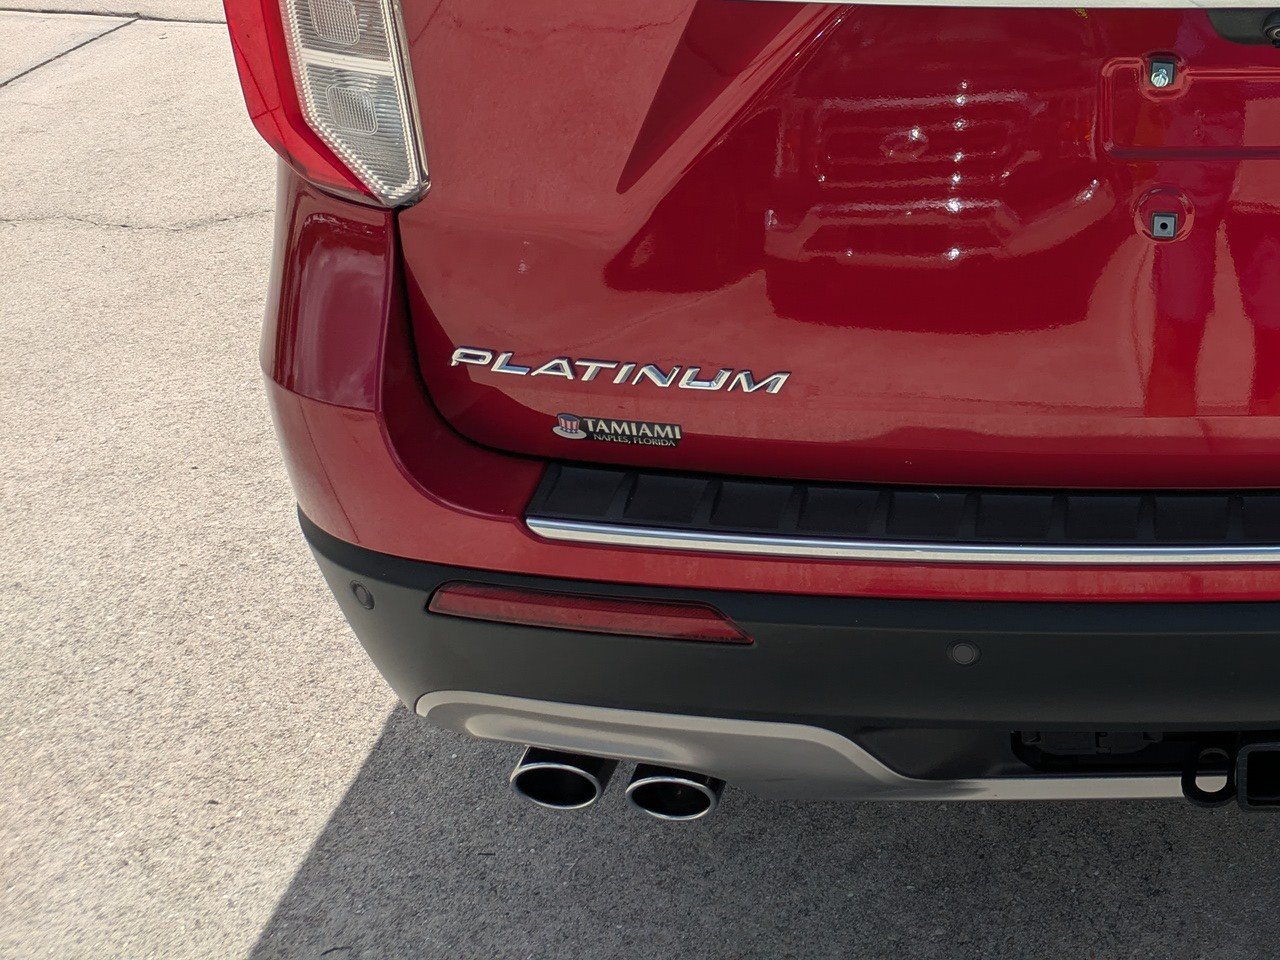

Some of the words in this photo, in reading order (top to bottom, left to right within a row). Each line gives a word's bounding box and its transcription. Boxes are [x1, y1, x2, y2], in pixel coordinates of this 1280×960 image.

[451, 346, 790, 394] PLATINUM
[583, 418, 681, 439] TAMIAMI
[633, 437, 676, 447] FLORIDA
